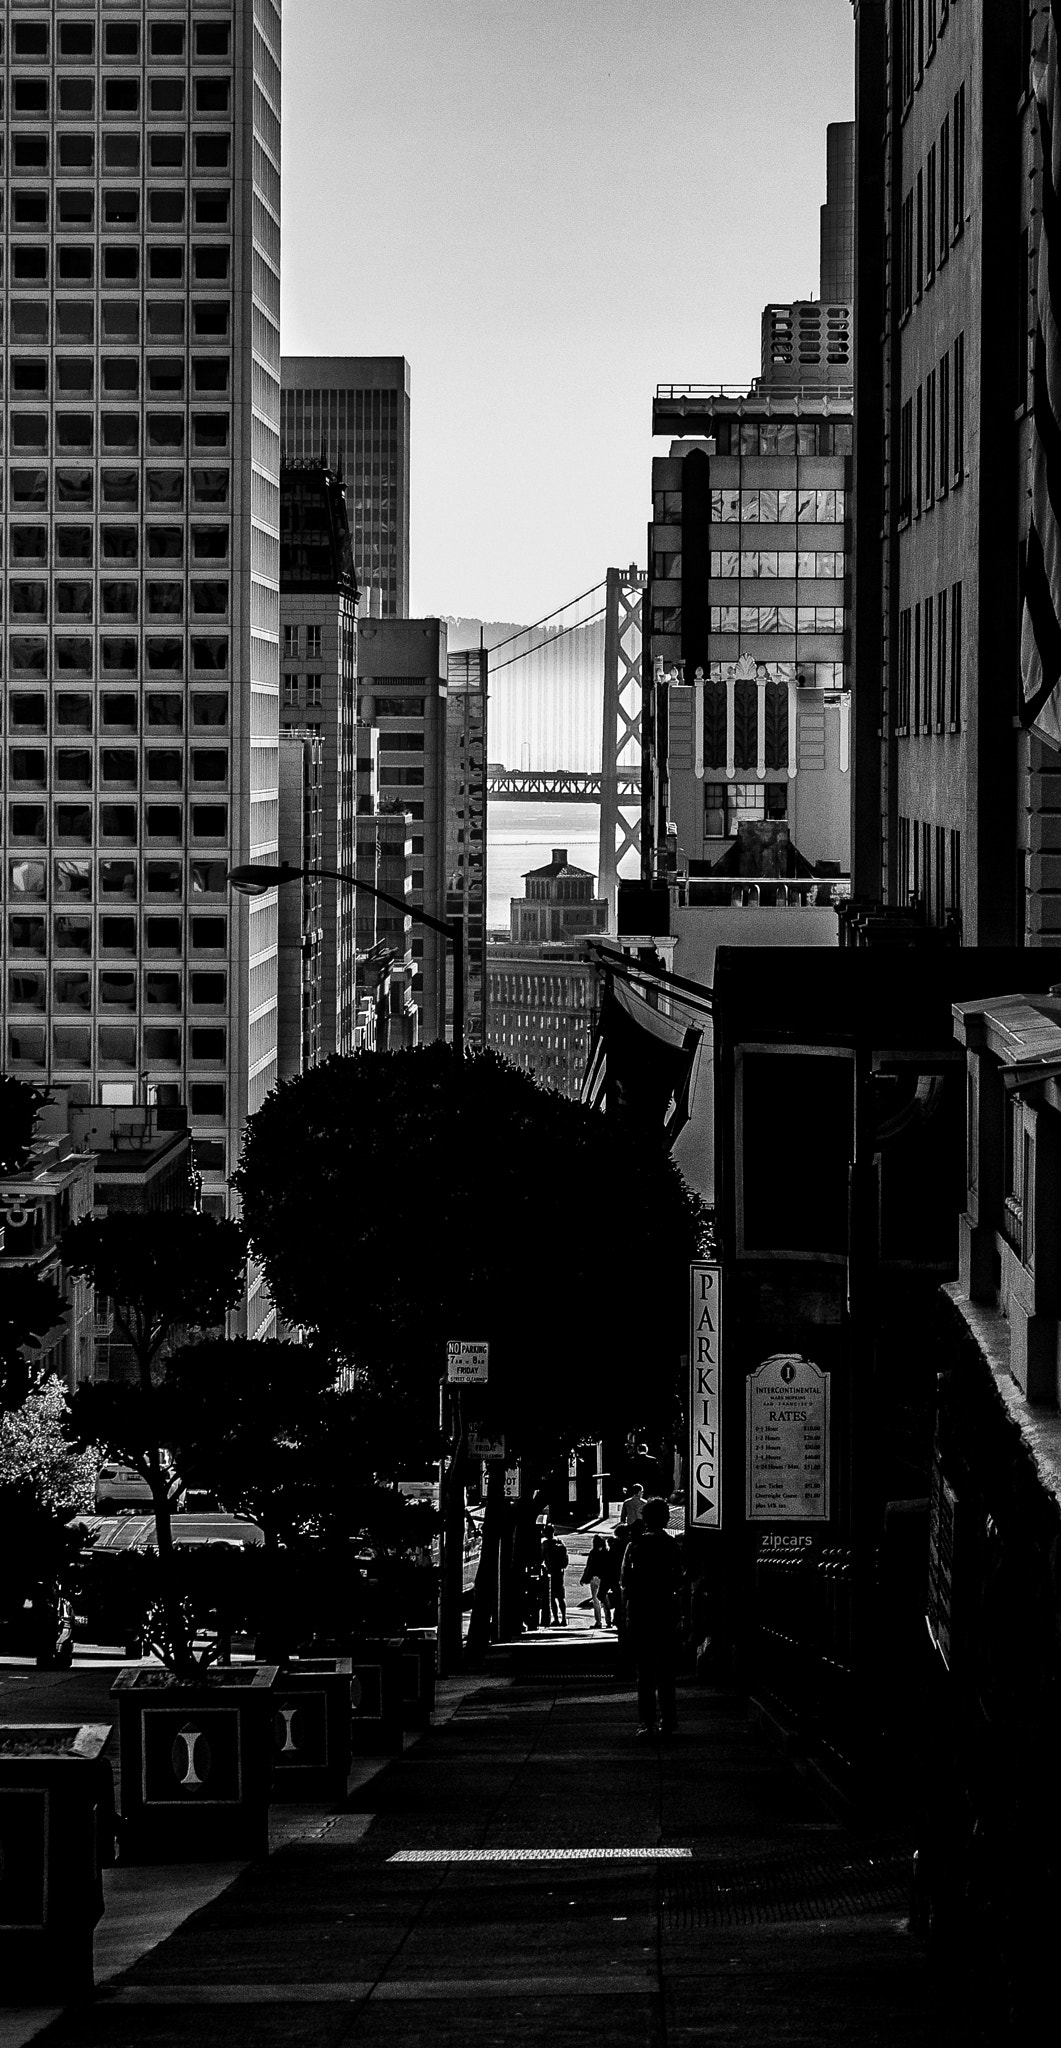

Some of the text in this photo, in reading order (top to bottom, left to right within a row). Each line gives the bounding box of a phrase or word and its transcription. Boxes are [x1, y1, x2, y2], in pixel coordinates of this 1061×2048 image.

[449, 1342, 488, 1354] NO PARKING
[456, 1366, 479, 1375] FRIDAY
[696, 1273, 715, 1489] PARKING
[769, 1411, 807, 1421] RATES
[761, 1531, 813, 1549] zipcars
